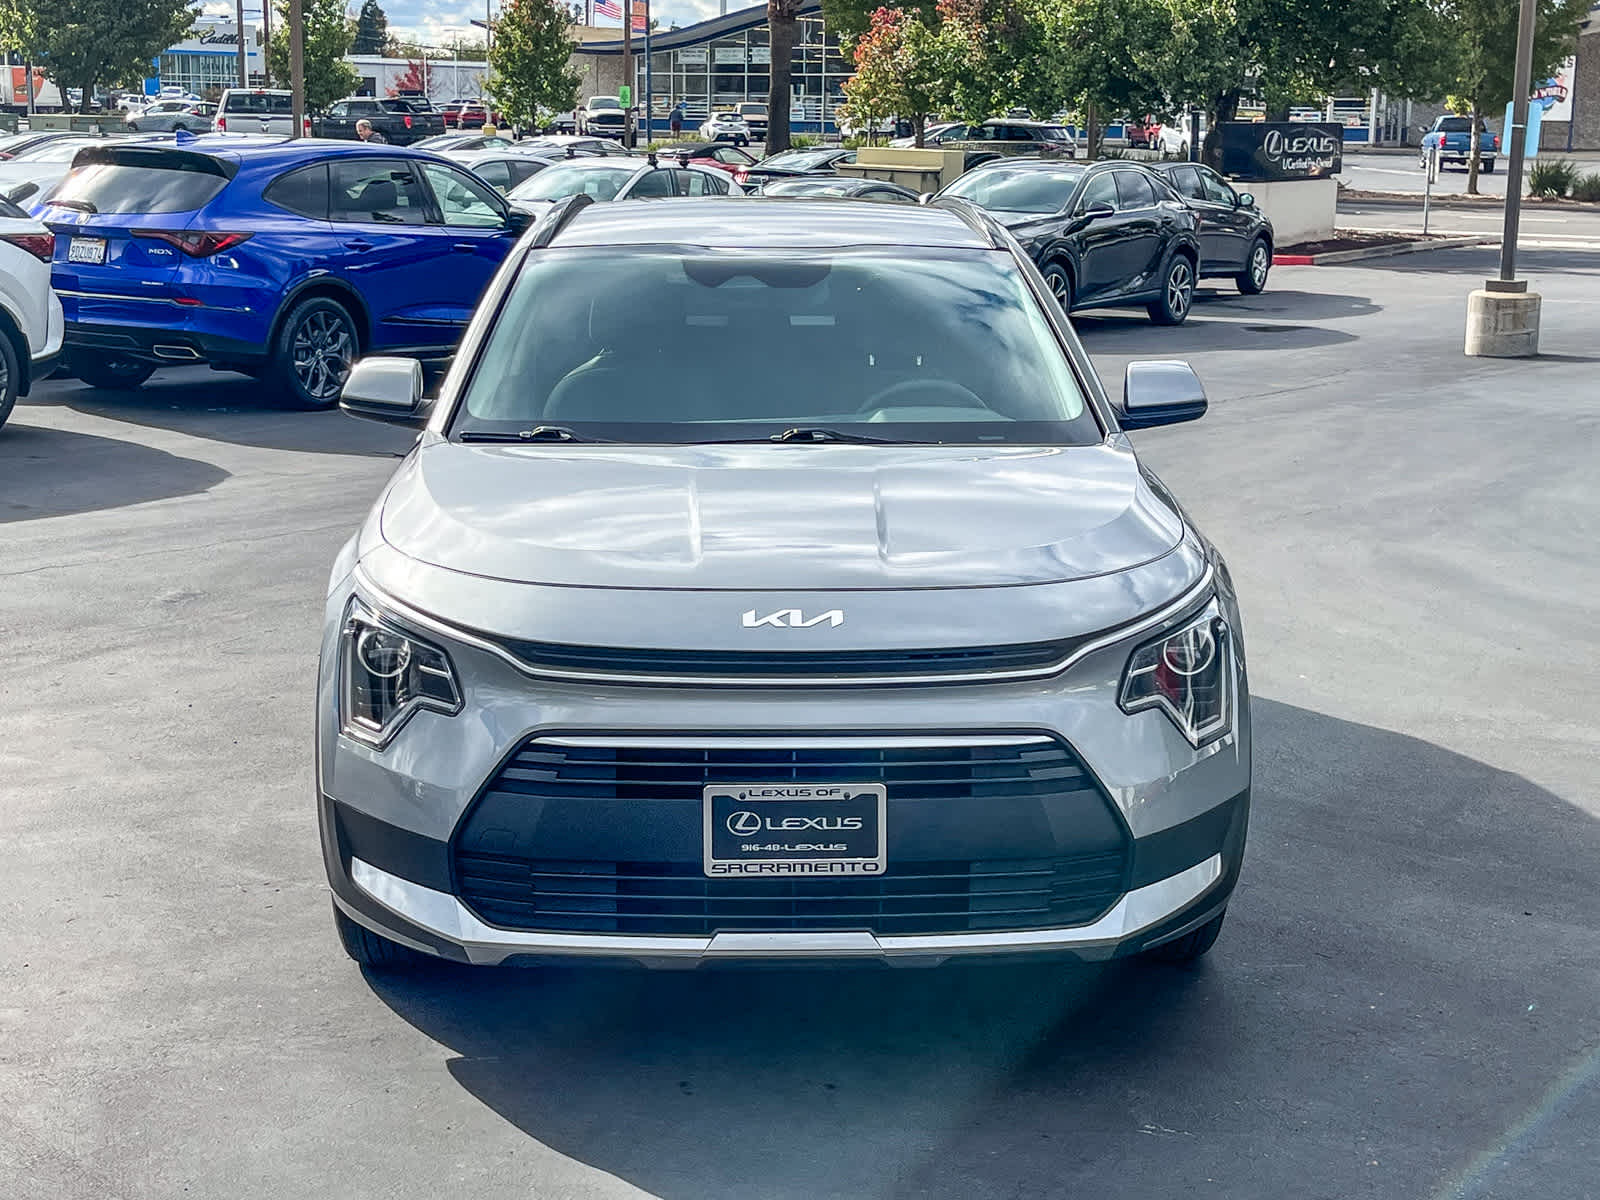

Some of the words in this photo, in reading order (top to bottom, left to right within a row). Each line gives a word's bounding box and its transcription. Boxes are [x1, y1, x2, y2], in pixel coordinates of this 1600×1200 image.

[1284, 137, 1334, 153] LEXUS
[148, 248, 173, 256] MDX
[743, 608, 844, 629] KIA
[749, 788, 812, 798] LEXUS
[816, 788, 841, 797] OF
[765, 816, 863, 830] LEXUS
[711, 862, 879, 874] SACRAMENTO
